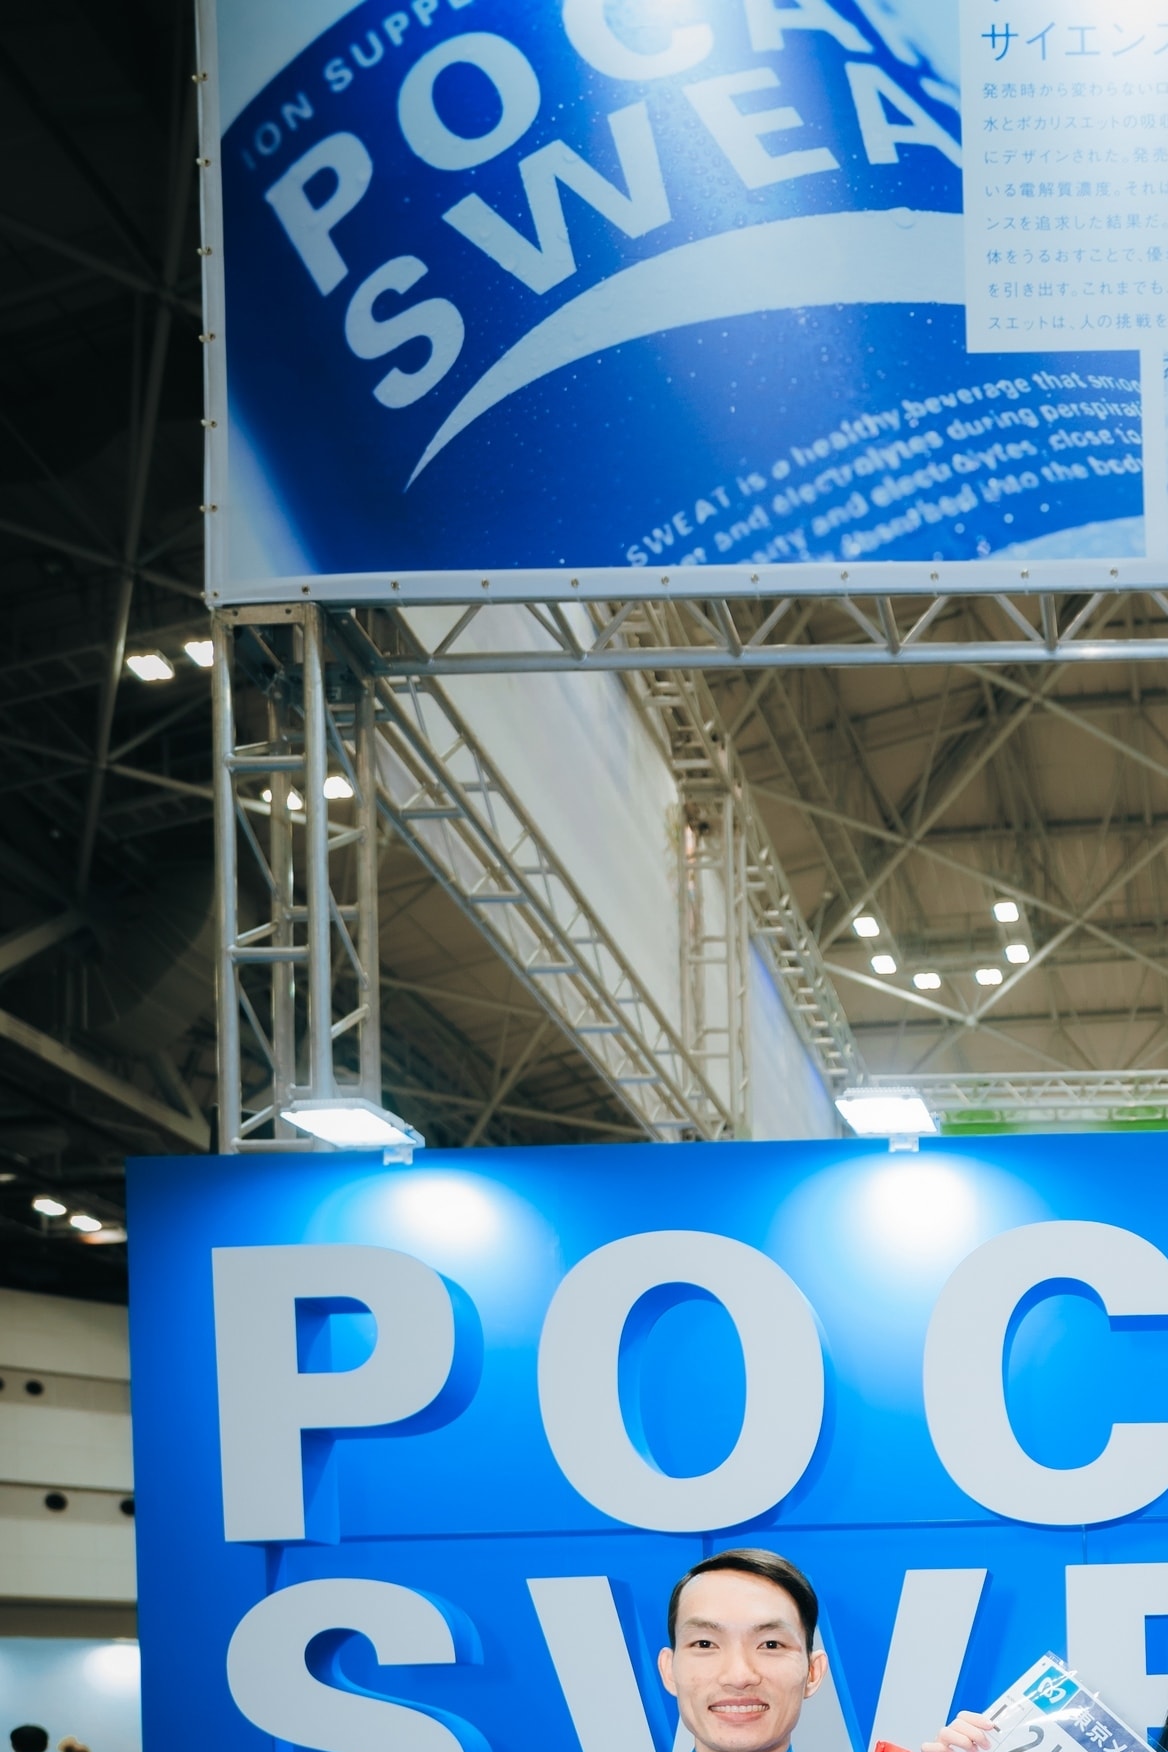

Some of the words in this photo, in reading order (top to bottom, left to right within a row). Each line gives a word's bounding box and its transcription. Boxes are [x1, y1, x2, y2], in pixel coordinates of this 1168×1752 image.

[242, 90, 316, 172] ION
[323, 0, 474, 92] SUPP
[344, 62, 961, 409] SWEA
[627, 485, 732, 565] SWEAT
[903, 377, 1032, 418] beverage
[1032, 371, 1087, 390] that
[947, 407, 1039, 441] during
[1041, 461, 1089, 483] the
[1048, 430, 1115, 452] close
